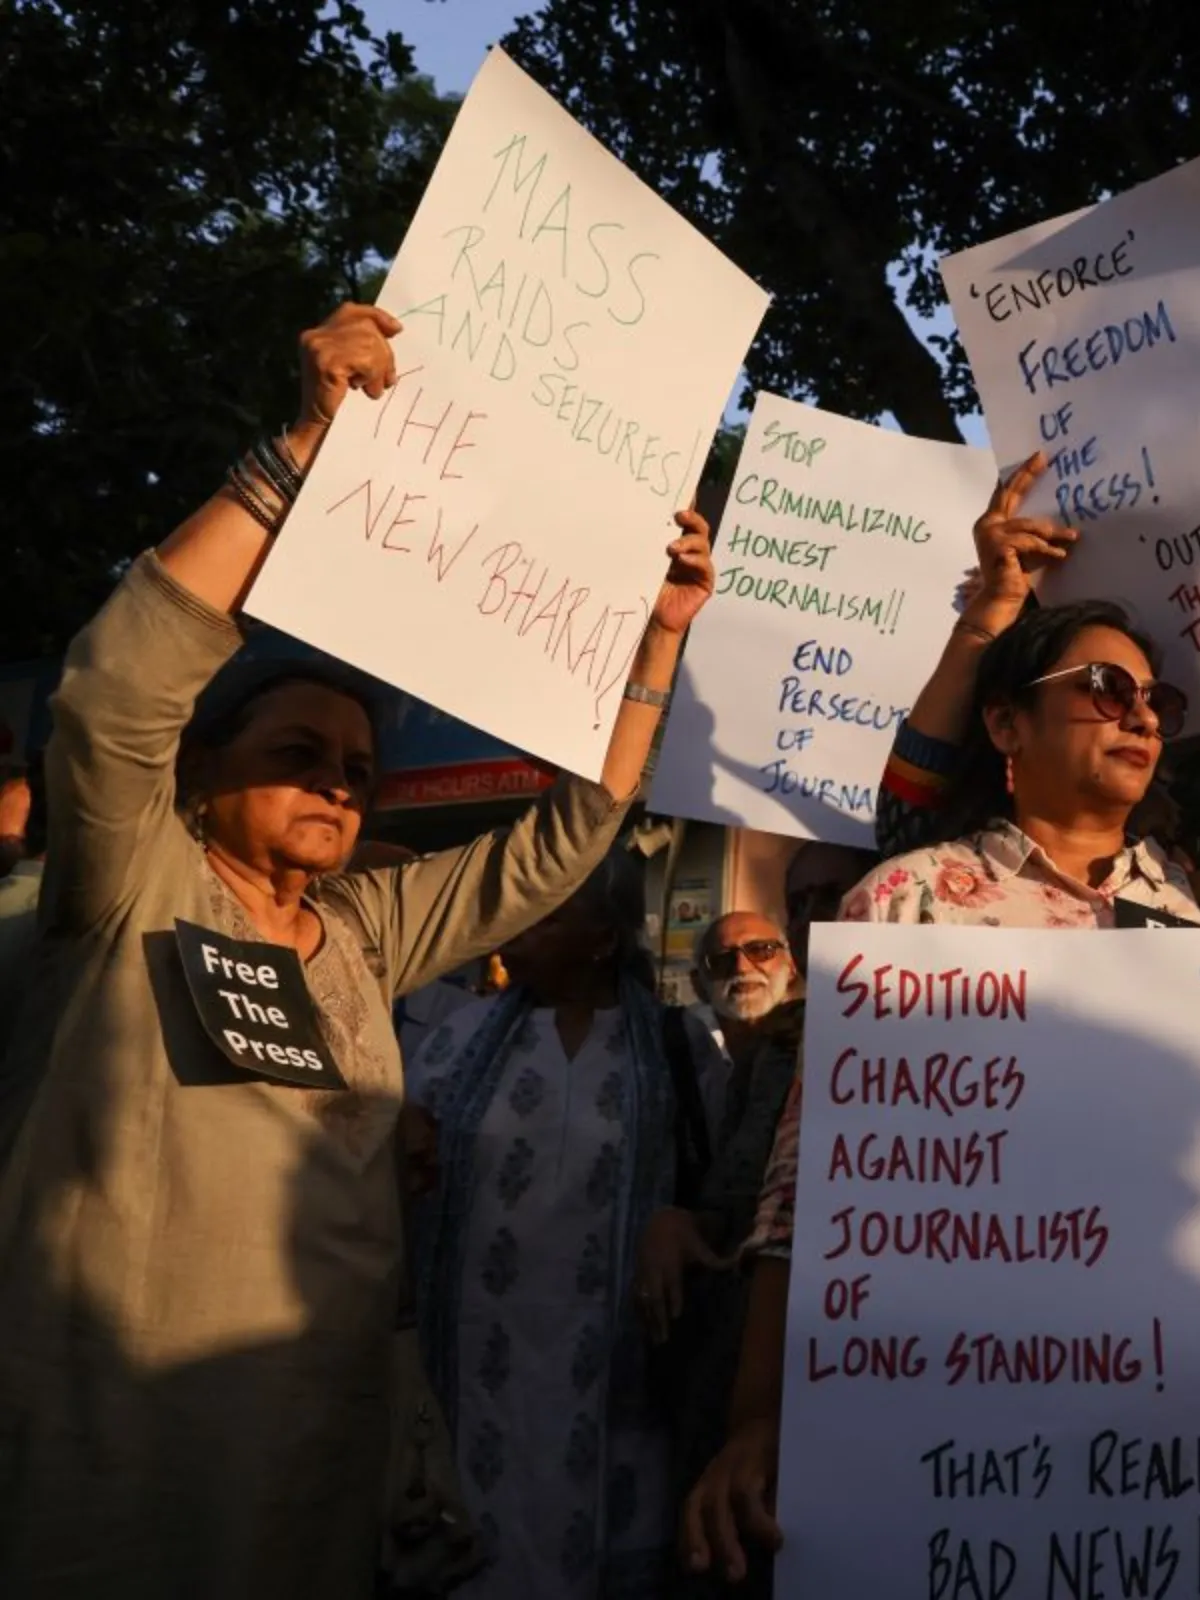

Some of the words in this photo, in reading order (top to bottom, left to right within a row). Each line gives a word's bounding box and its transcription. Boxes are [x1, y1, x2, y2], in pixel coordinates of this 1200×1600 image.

[483, 134, 661, 325] MASS
[442, 225, 592, 371] RAIDS
[399, 293, 516, 381] AND
[1018, 300, 1177, 395] FREEDOM
[373, 365, 488, 480] THE
[531, 373, 703, 526] SEIZURES!
[761, 420, 827, 468] STOP
[1047, 436, 1098, 481] THE
[1055, 445, 1160, 530] PRESS!
[326, 479, 479, 583] NEW
[735, 474, 932, 544] CRIMINALIZING
[728, 523, 838, 571] HONEST
[716, 565, 906, 636] JOURNALISM!!
[793, 639, 853, 676] END
[423, 771, 494, 798] HOURS
[498, 767, 541, 792] ATM
[758, 759, 874, 814] JOURNA
[201, 943, 279, 989] Free
[836, 953, 1027, 1022] SEDITION
[218, 989, 289, 1029] The
[223, 1029, 324, 1071] Press
[830, 1046, 1026, 1117] CHARGES
[827, 1129, 1009, 1188] AGAINST
[823, 1205, 1109, 1267] JOURNALISTS
[823, 1273, 871, 1320] OF
[809, 1336, 928, 1383] LONG
[944, 1316, 1164, 1393] STANDING!
[920, 1434, 1052, 1499] THAT'S
[928, 1528, 1016, 1600] BAD
